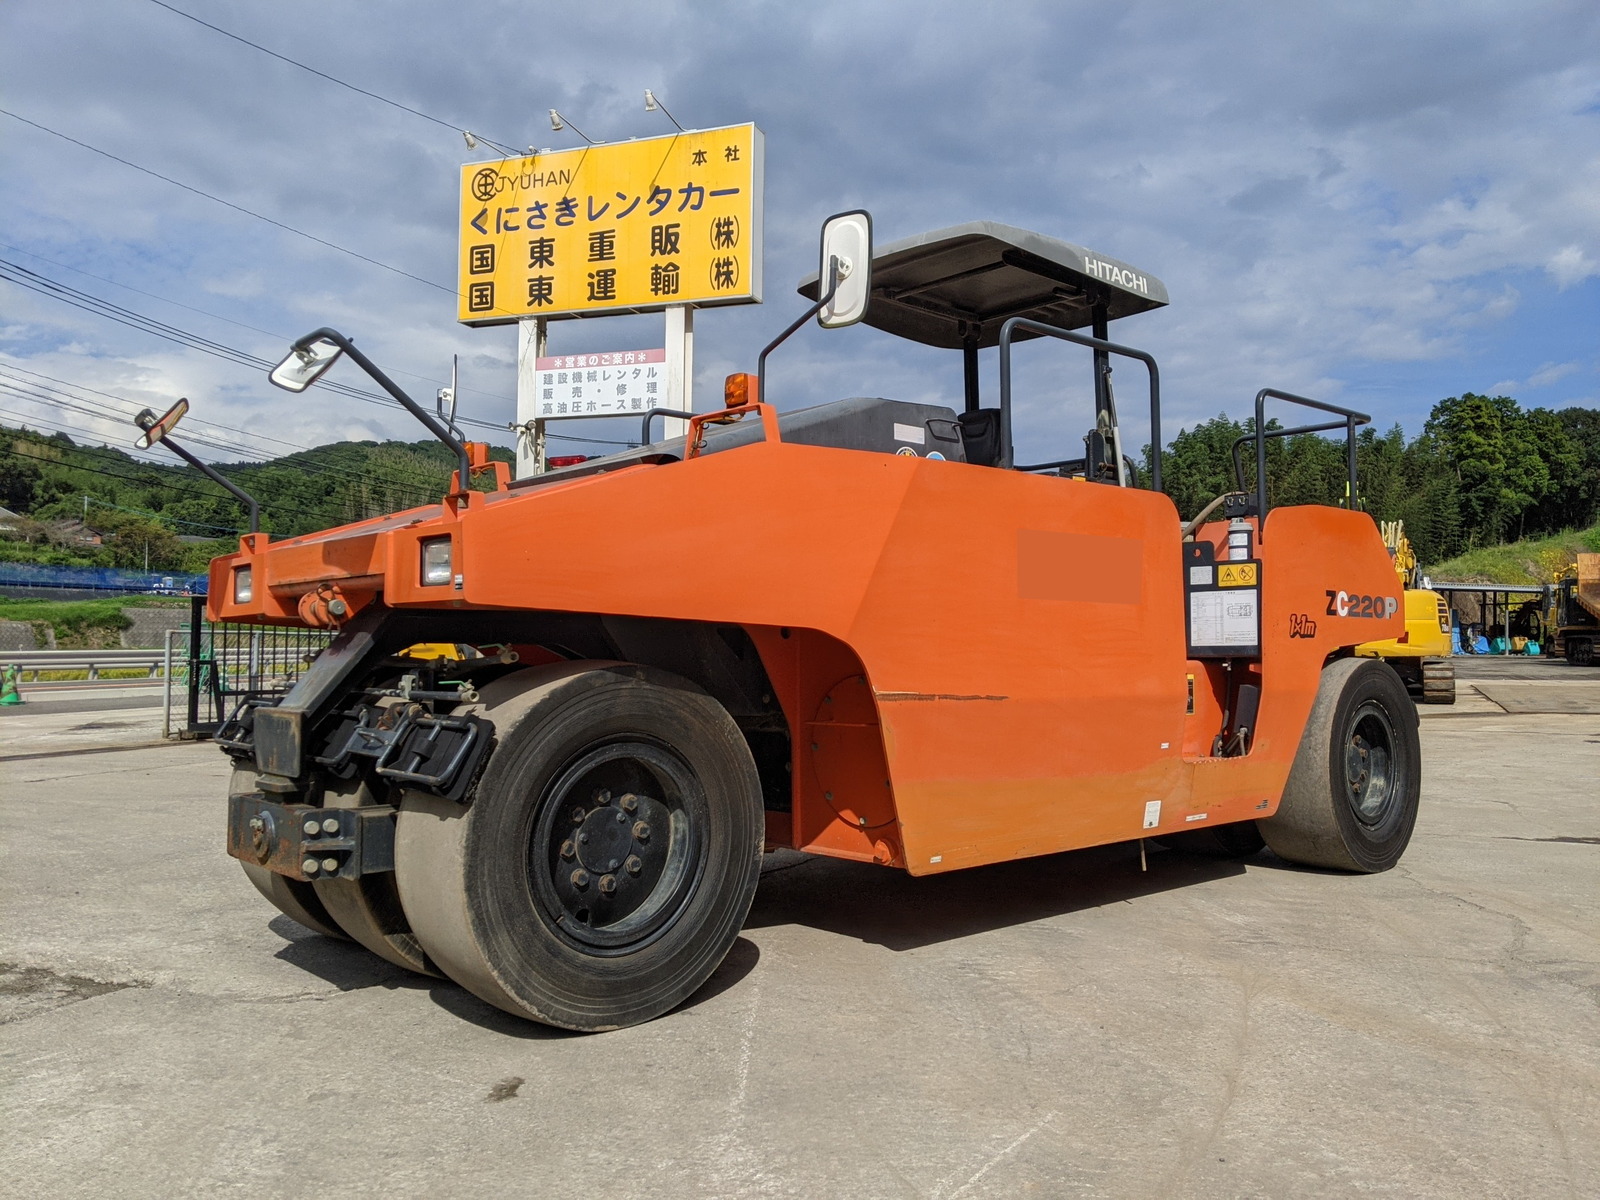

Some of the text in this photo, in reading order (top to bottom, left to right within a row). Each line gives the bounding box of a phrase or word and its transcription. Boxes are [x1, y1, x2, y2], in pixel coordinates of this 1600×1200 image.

[692, 145, 740, 166] 本社
[494, 169, 571, 193] JYUHAN
[470, 182, 740, 234] くにさきレンタカー
[1084, 256, 1148, 294] HITACHI
[543, 367, 657, 385] 建設機械レンタル
[543, 397, 657, 415] 高油圧ホース製作
[1325, 590, 1398, 619] ZC220P
